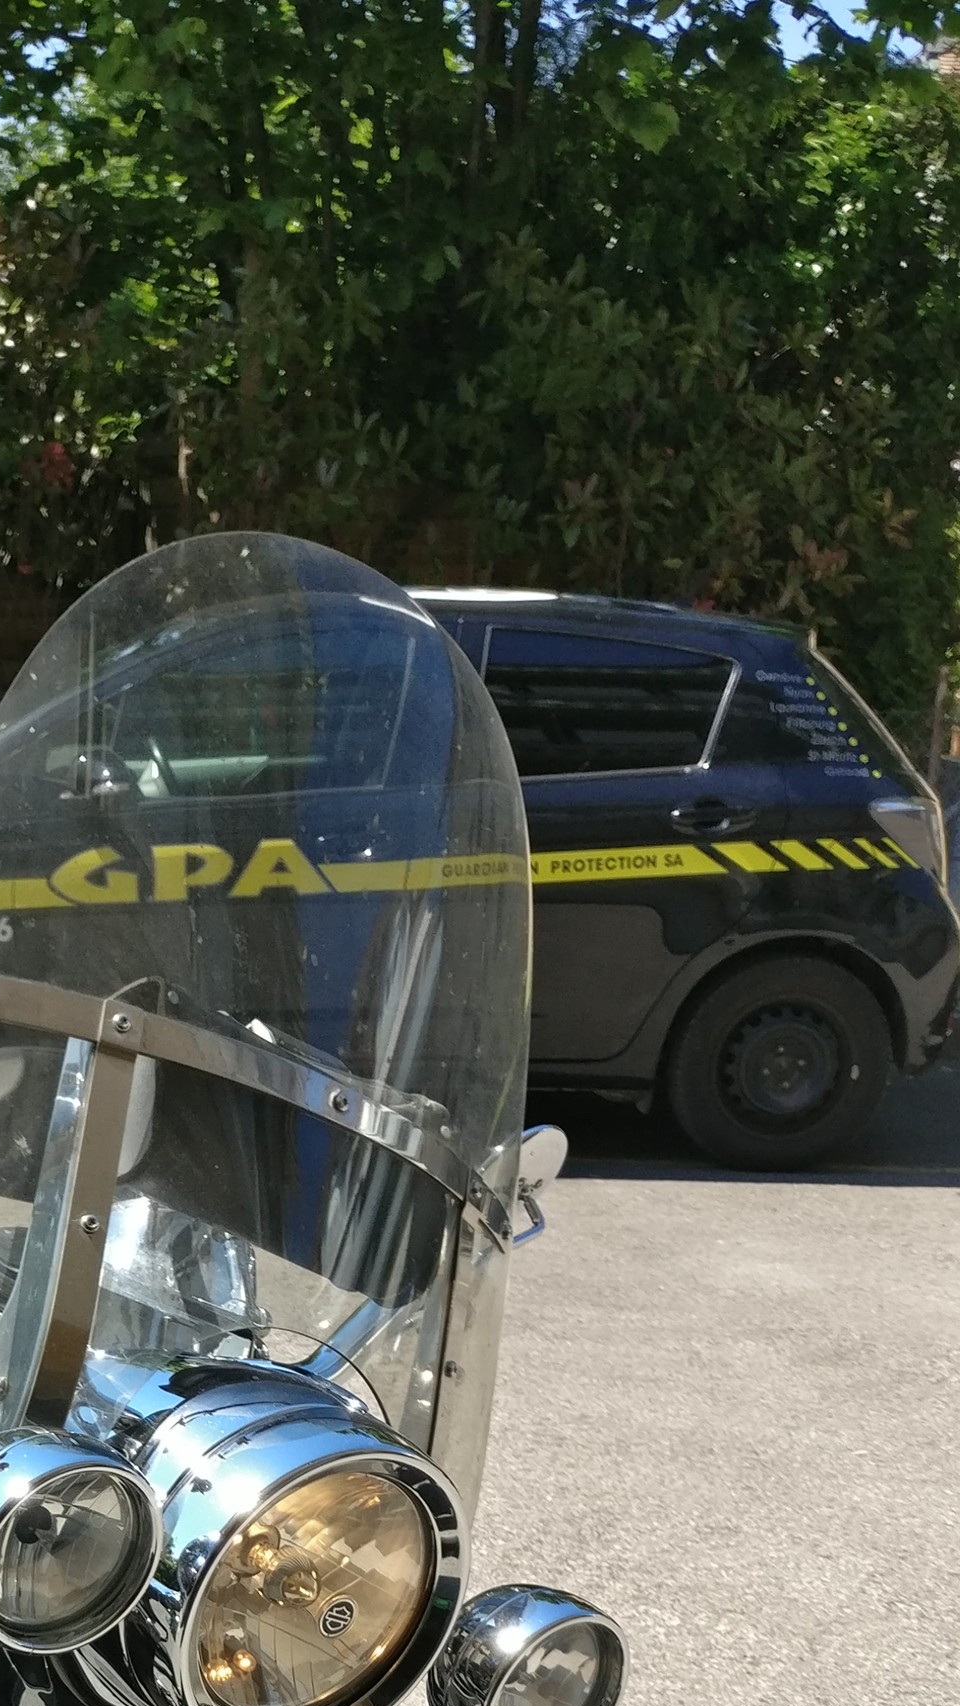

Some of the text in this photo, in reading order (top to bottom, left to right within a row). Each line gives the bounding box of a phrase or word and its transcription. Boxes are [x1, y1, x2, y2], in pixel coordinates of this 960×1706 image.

[48, 837, 333, 904] GPA
[550, 854, 658, 874] PROTECTION
[663, 853, 685, 868] SA
